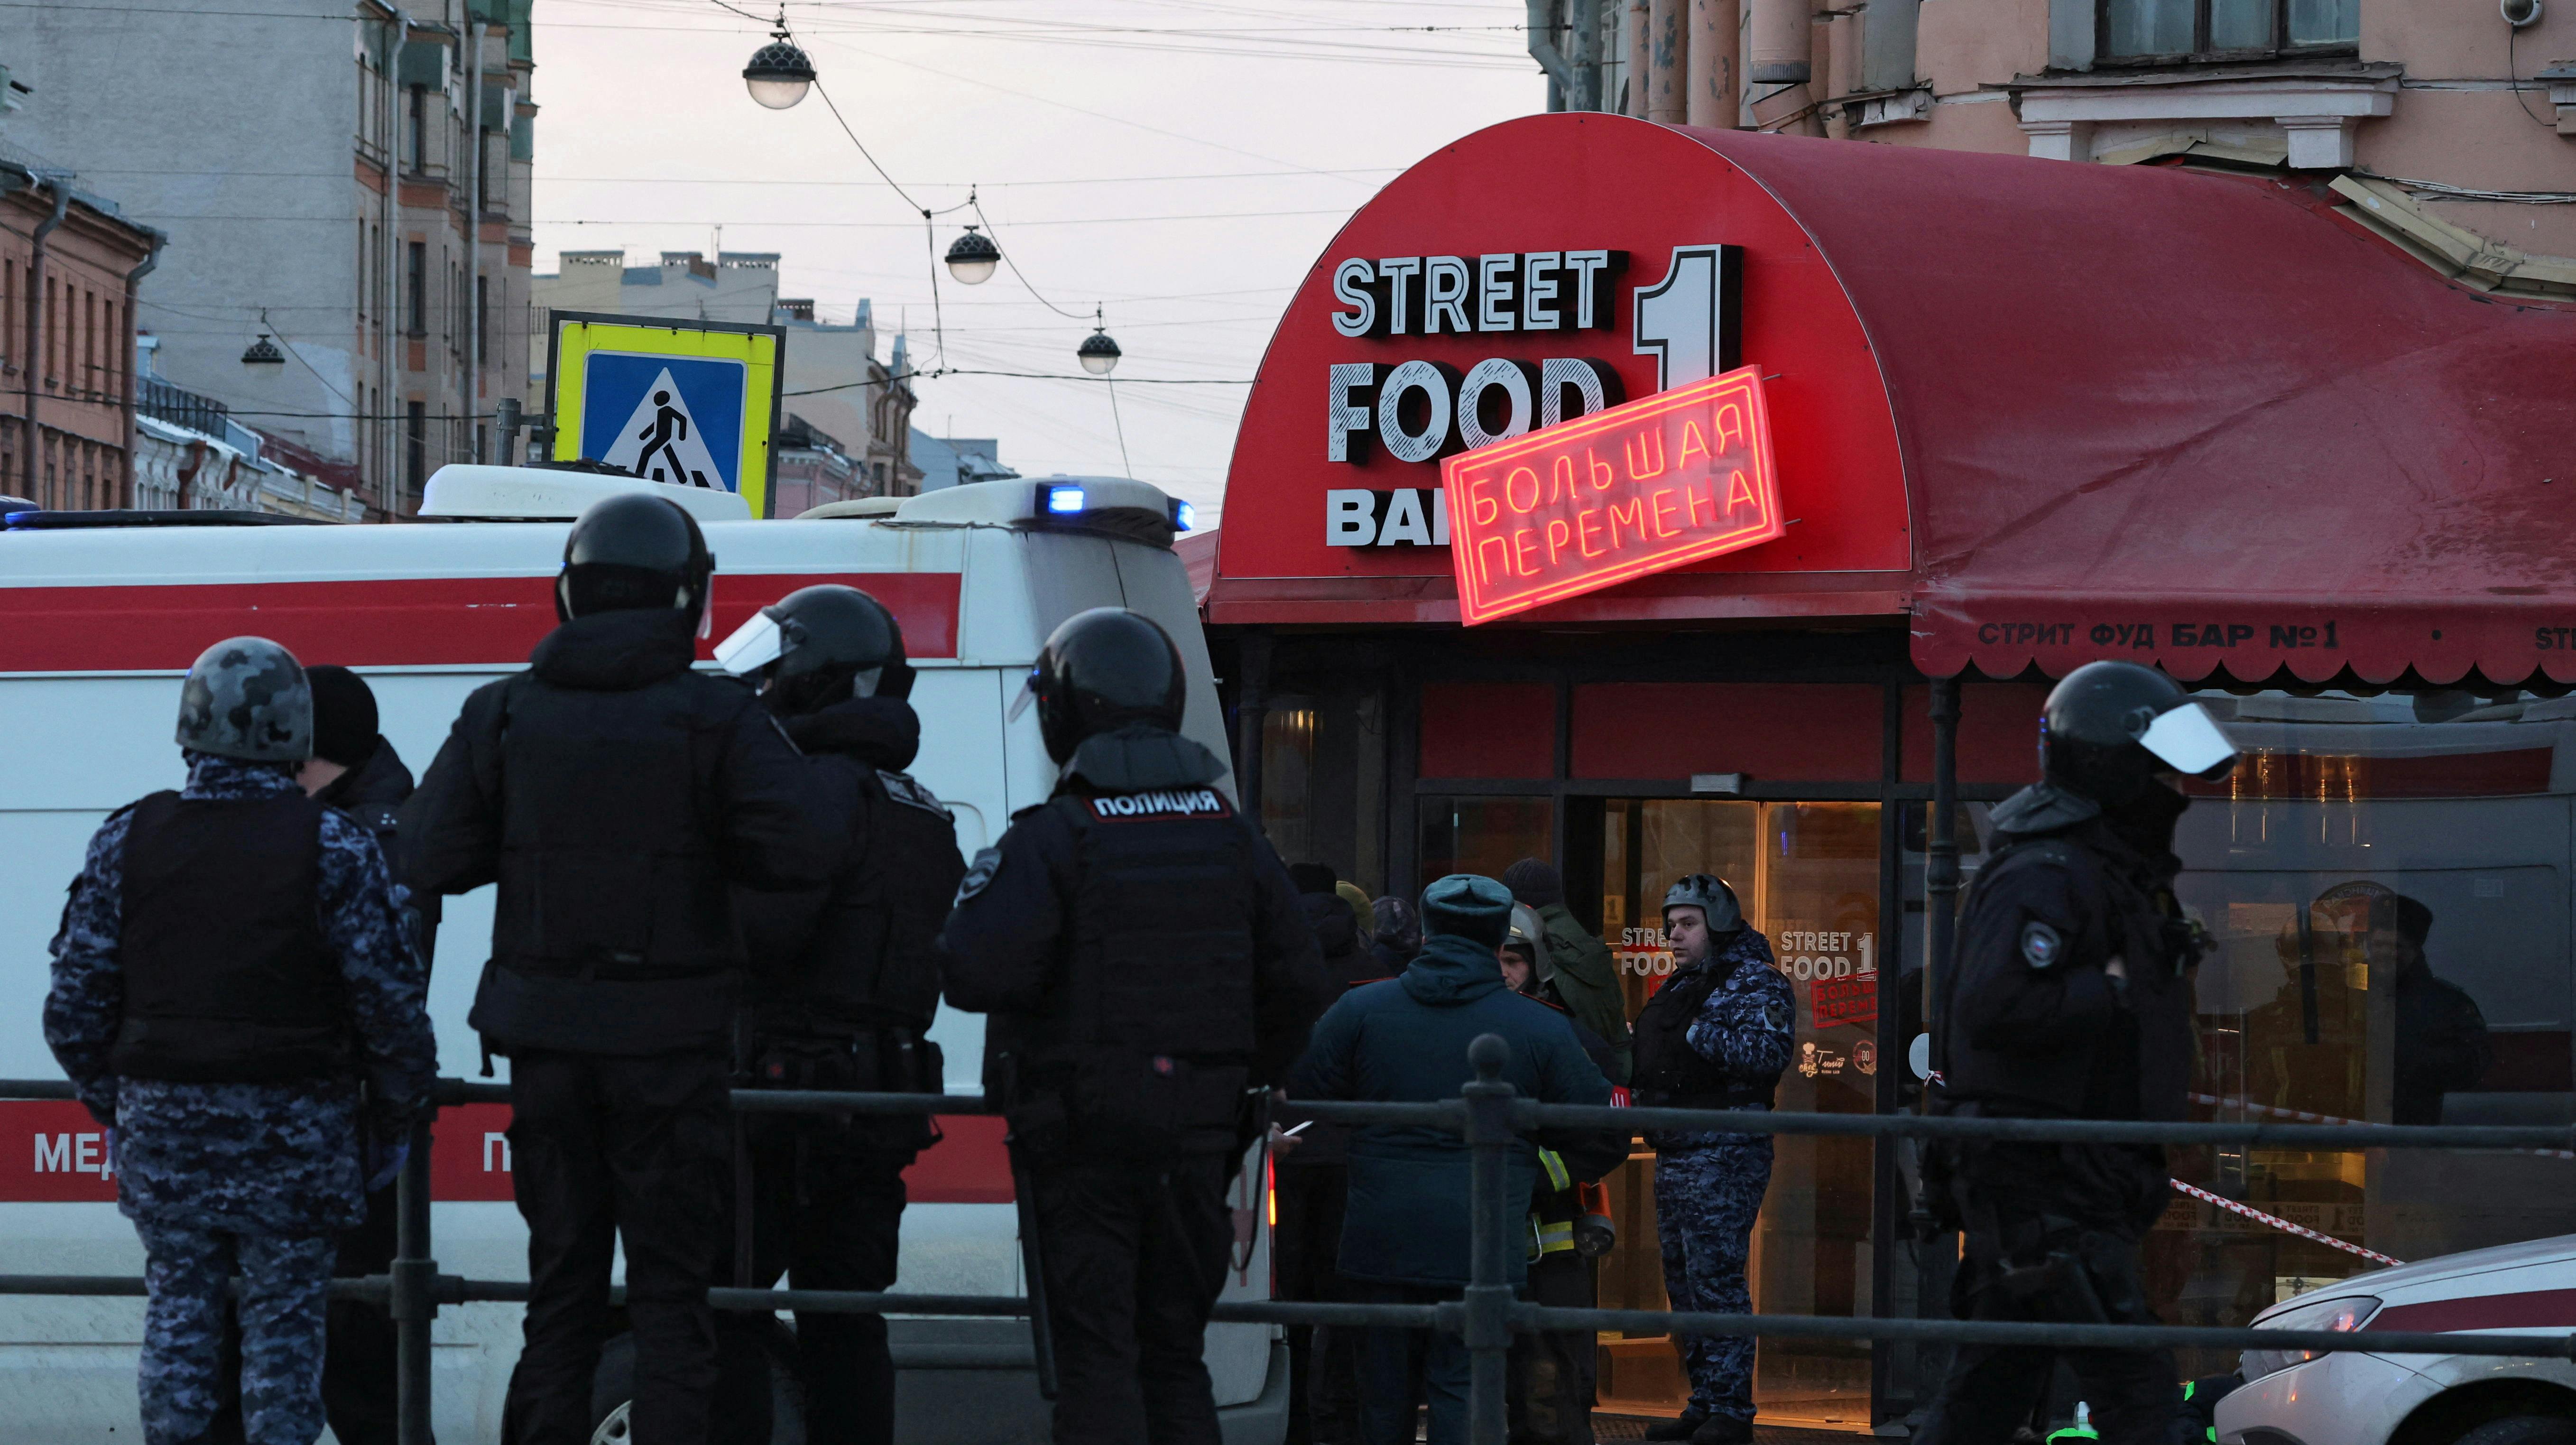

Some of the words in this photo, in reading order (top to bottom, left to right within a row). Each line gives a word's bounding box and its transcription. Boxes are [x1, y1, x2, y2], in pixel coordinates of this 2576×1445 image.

[1331, 250, 1608, 338] STREET
[1633, 244, 1722, 391] 1
[1328, 357, 1606, 463] FOOD
[1471, 401, 1745, 526] БОЛЬШАЯ
[1477, 469, 1757, 586] ПЕРЕМЕНА
[1977, 622, 2074, 645] СТРИТ
[2089, 622, 2155, 649] ФУД
[2171, 623, 2253, 648] БАР
[2269, 620, 2338, 649] №1
[2535, 627, 2576, 650] ST
[1092, 789, 1221, 816] ПОЛИЦИЯ
[1622, 927, 1670, 947] STRE
[1781, 932, 1851, 952] STREET
[1621, 951, 1677, 976] FOO
[1781, 956, 1851, 982] FOOD
[1856, 932, 1876, 982] 1
[1817, 981, 1875, 1001] БОЛЬШ
[1819, 996, 1877, 1019] ПЕРЕМЕ
